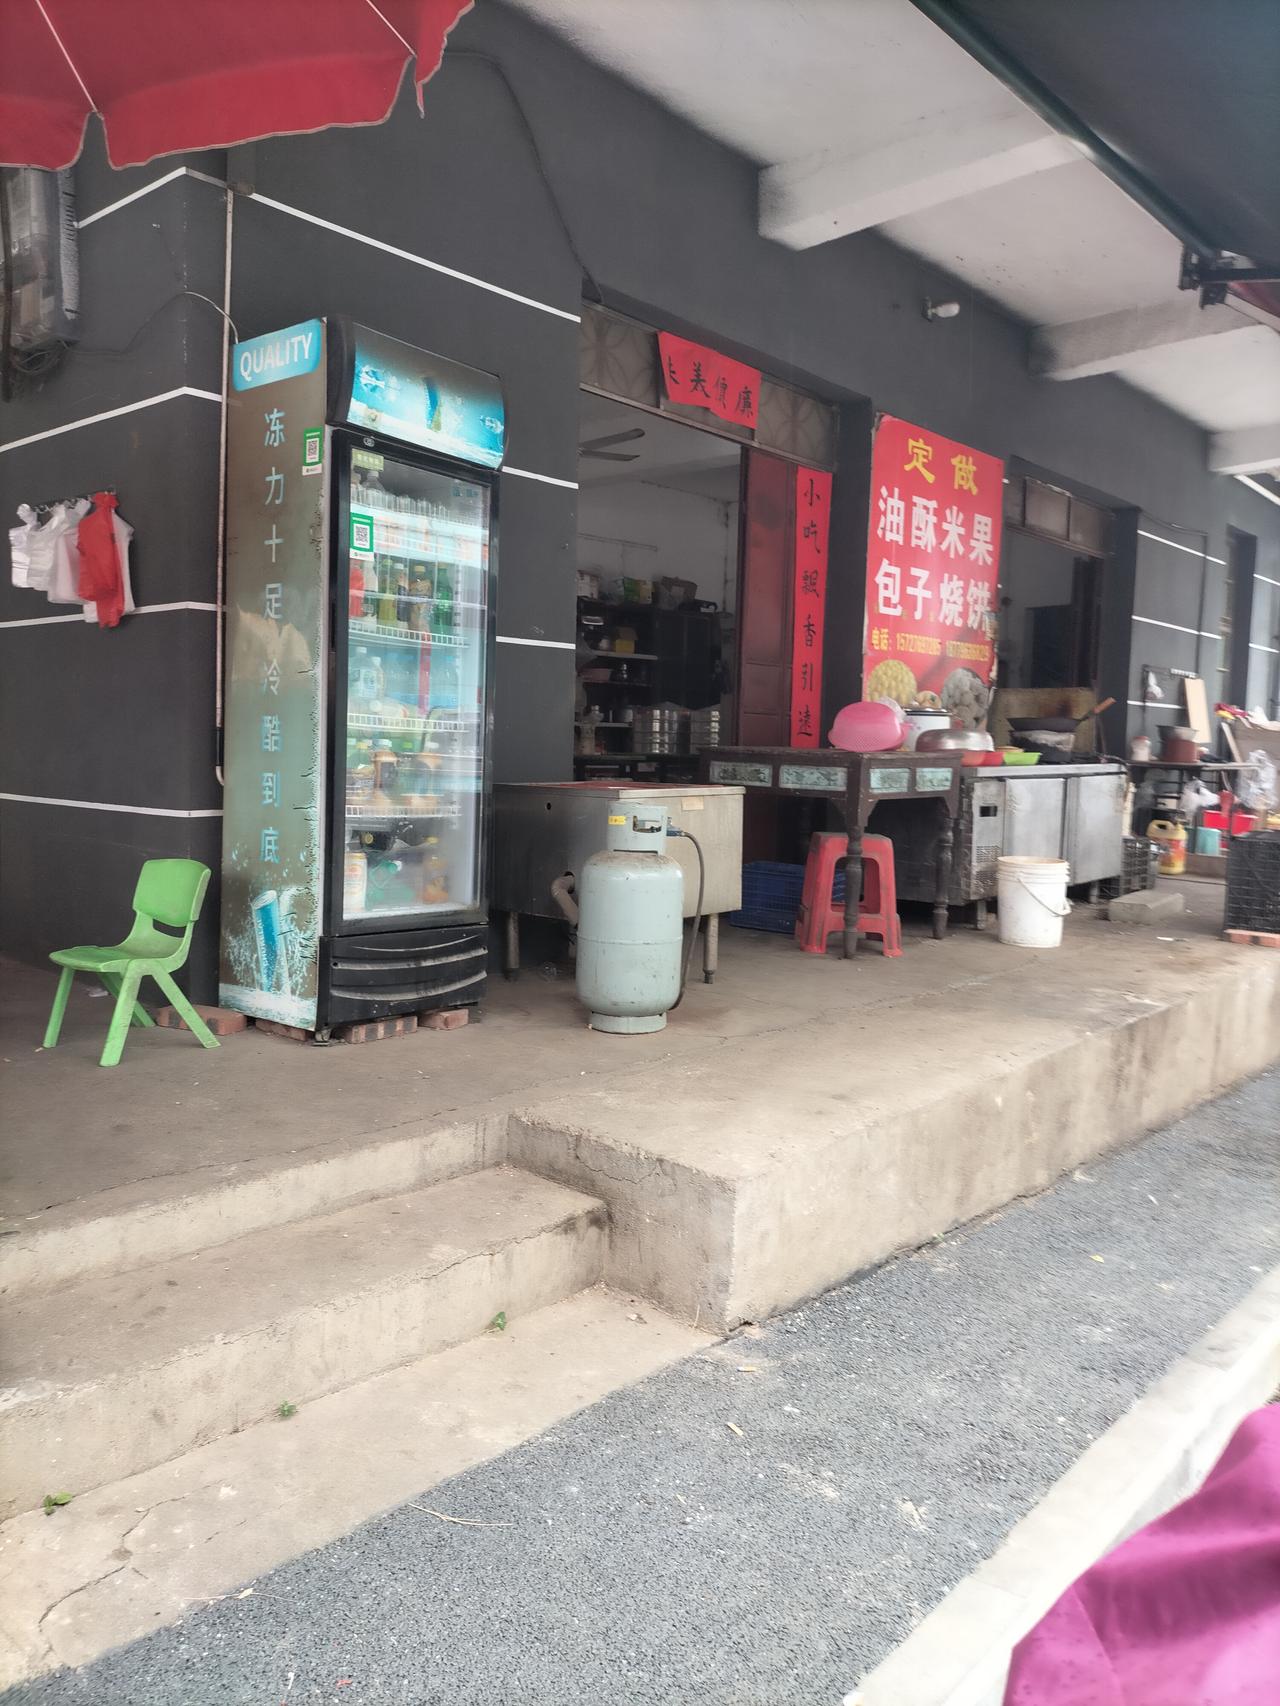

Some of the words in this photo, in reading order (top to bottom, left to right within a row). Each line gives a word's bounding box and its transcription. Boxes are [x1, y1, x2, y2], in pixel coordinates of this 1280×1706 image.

[240, 332, 313, 380] QUALITY
[904, 438, 979, 496] 定做
[264, 408, 285, 619] 冻力十足
[876, 485, 994, 566] 油酥米果
[875, 559, 992, 631] 包子烧饼
[262, 659, 282, 864] 冷酷到底
